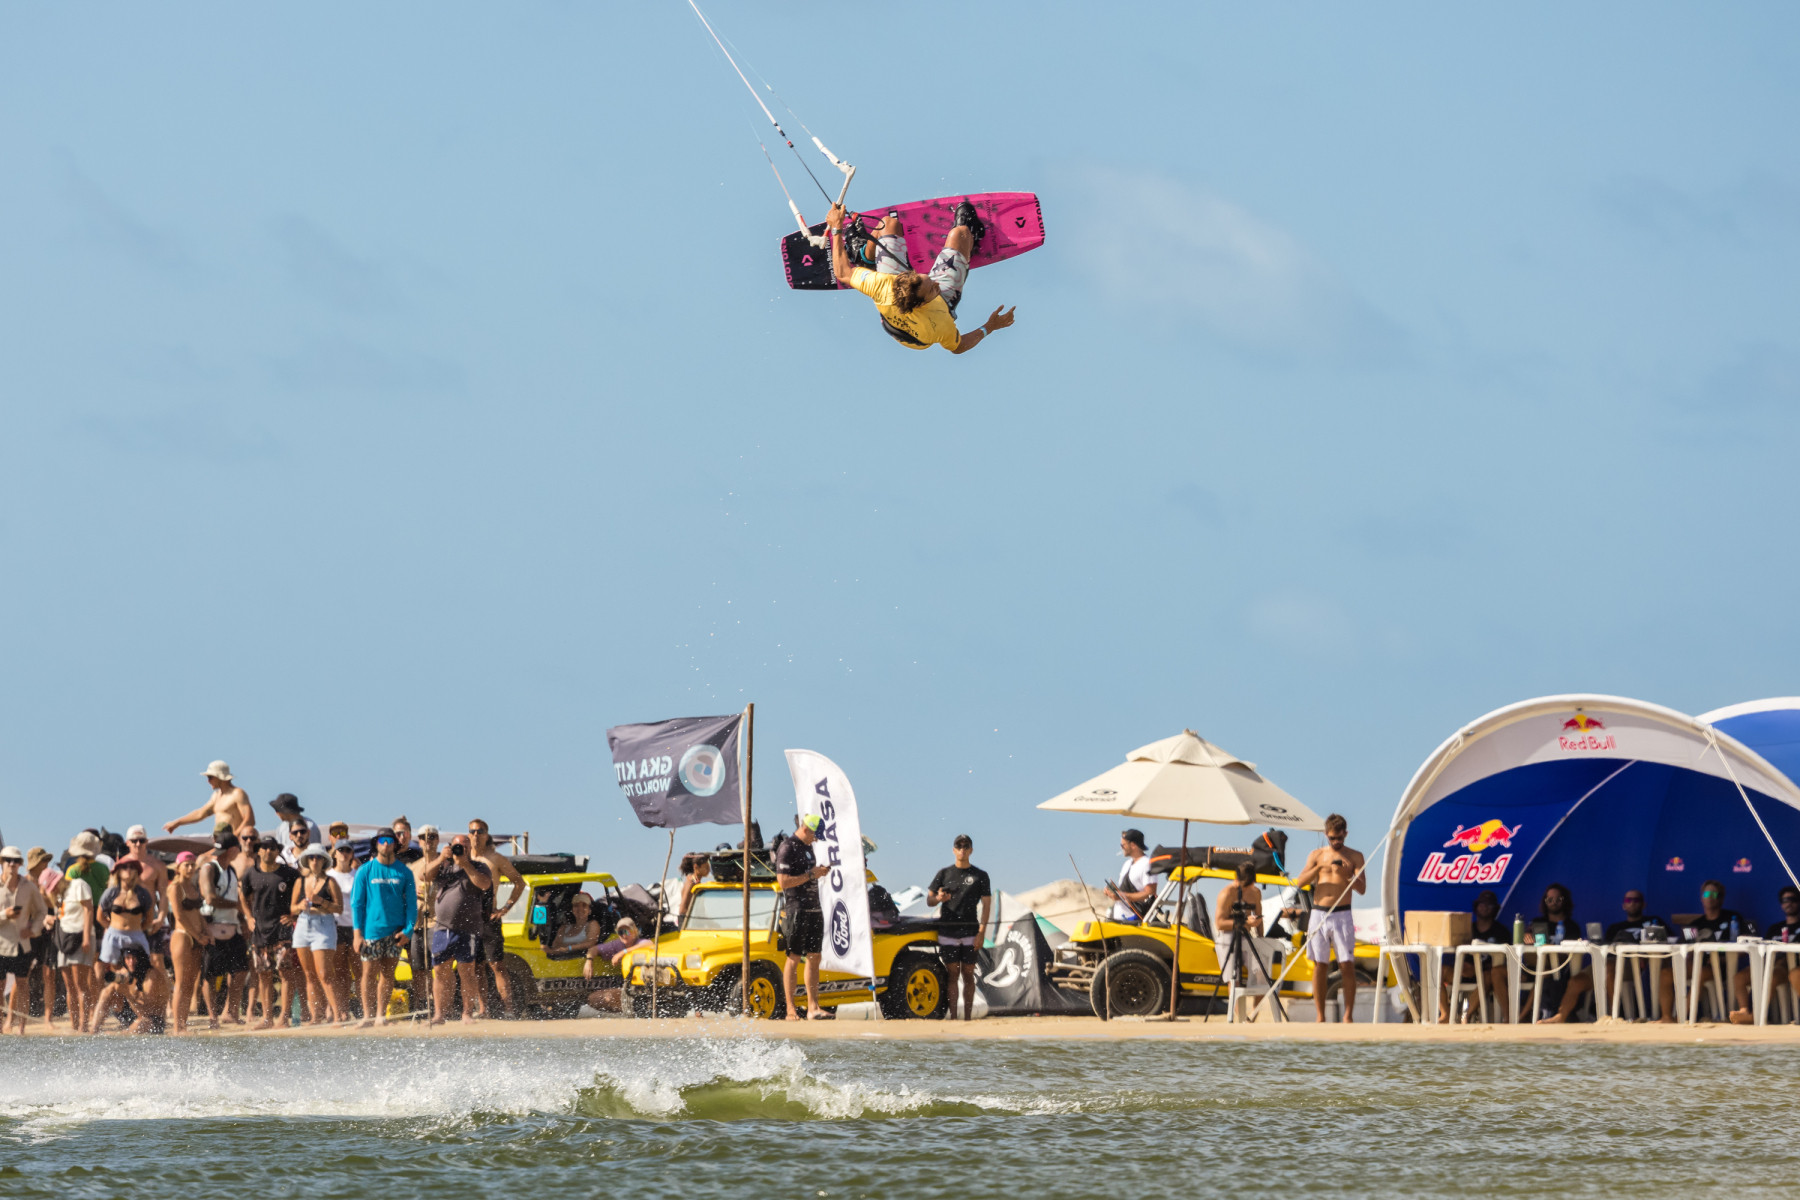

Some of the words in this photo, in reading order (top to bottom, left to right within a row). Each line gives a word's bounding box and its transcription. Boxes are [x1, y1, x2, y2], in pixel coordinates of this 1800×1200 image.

[1558, 736, 1587, 751] Red
[1587, 734, 1616, 750] Bull
[815, 777, 844, 892] CRASA
[833, 910, 849, 949] Ford
